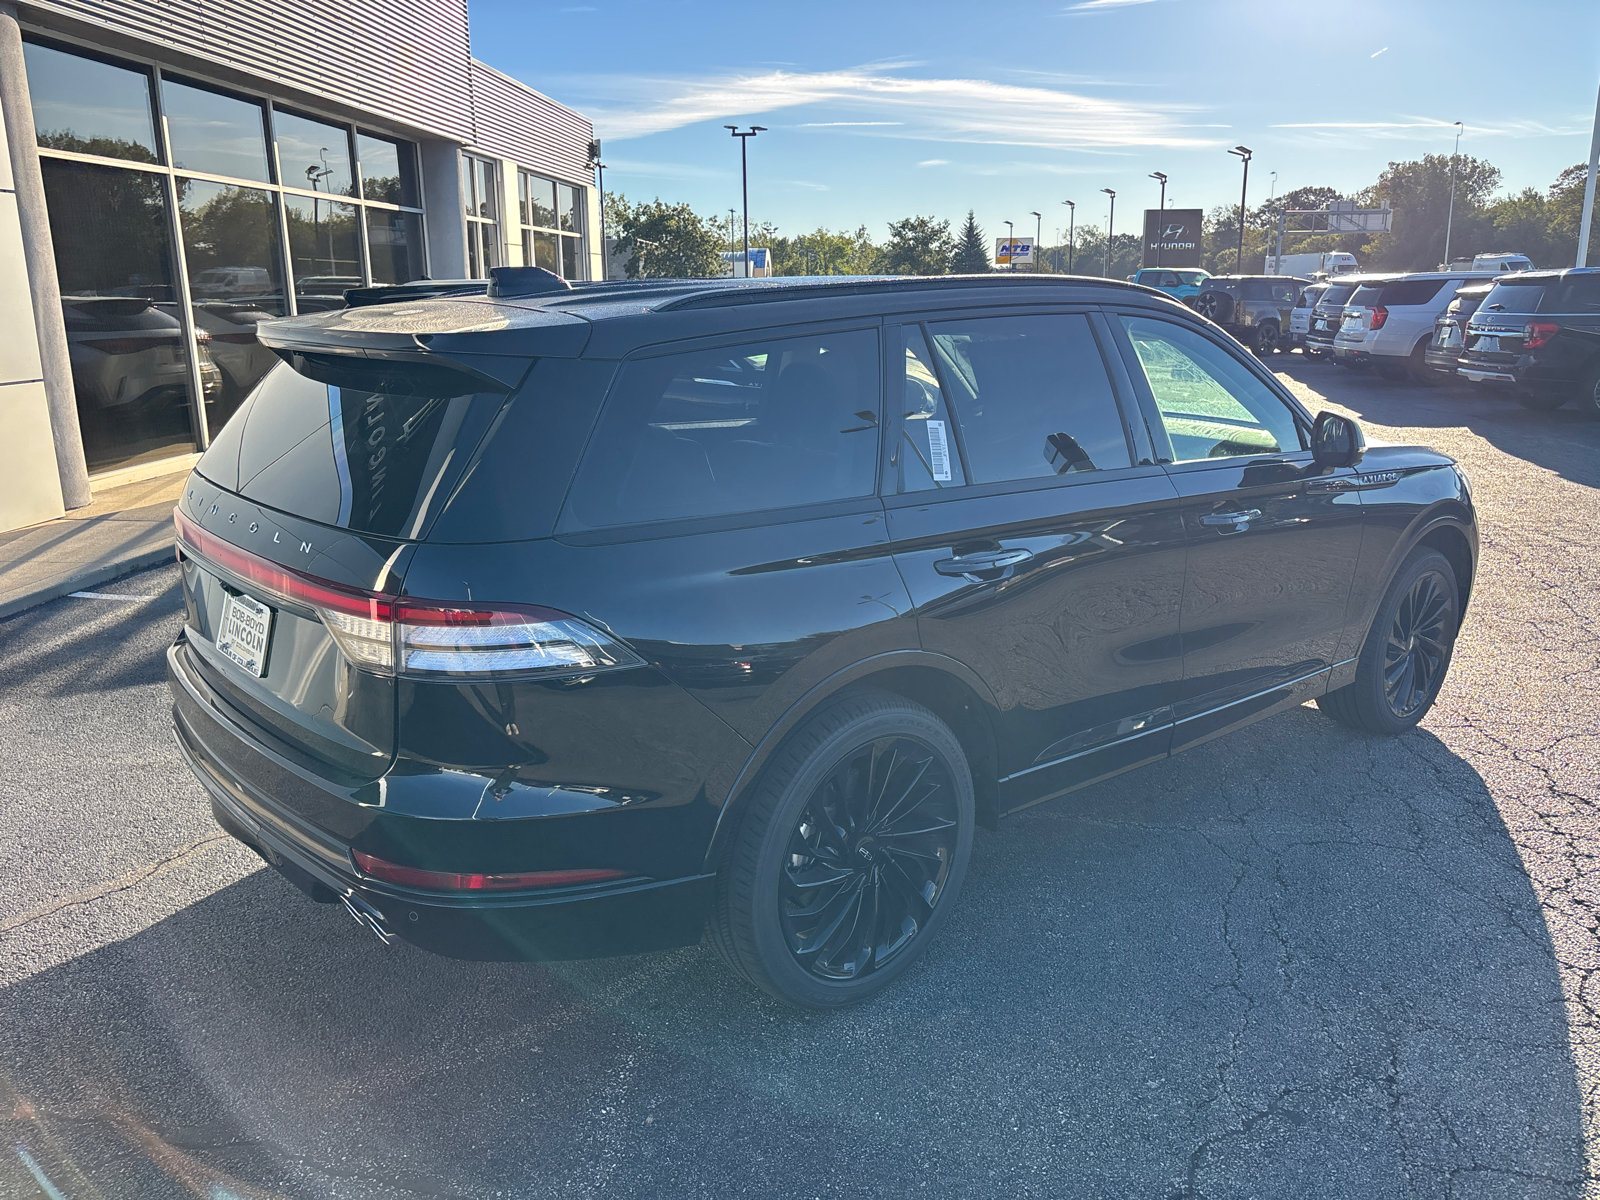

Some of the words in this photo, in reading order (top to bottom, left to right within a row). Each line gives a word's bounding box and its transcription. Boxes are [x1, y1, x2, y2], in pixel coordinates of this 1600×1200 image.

[1000, 244, 1031, 252] NTB
[1150, 242, 1195, 251] HYUNDAI
[1363, 472, 1398, 483] AVIATOR
[188, 490, 312, 554] LINCOLN
[228, 619, 264, 653] LINCOLN
